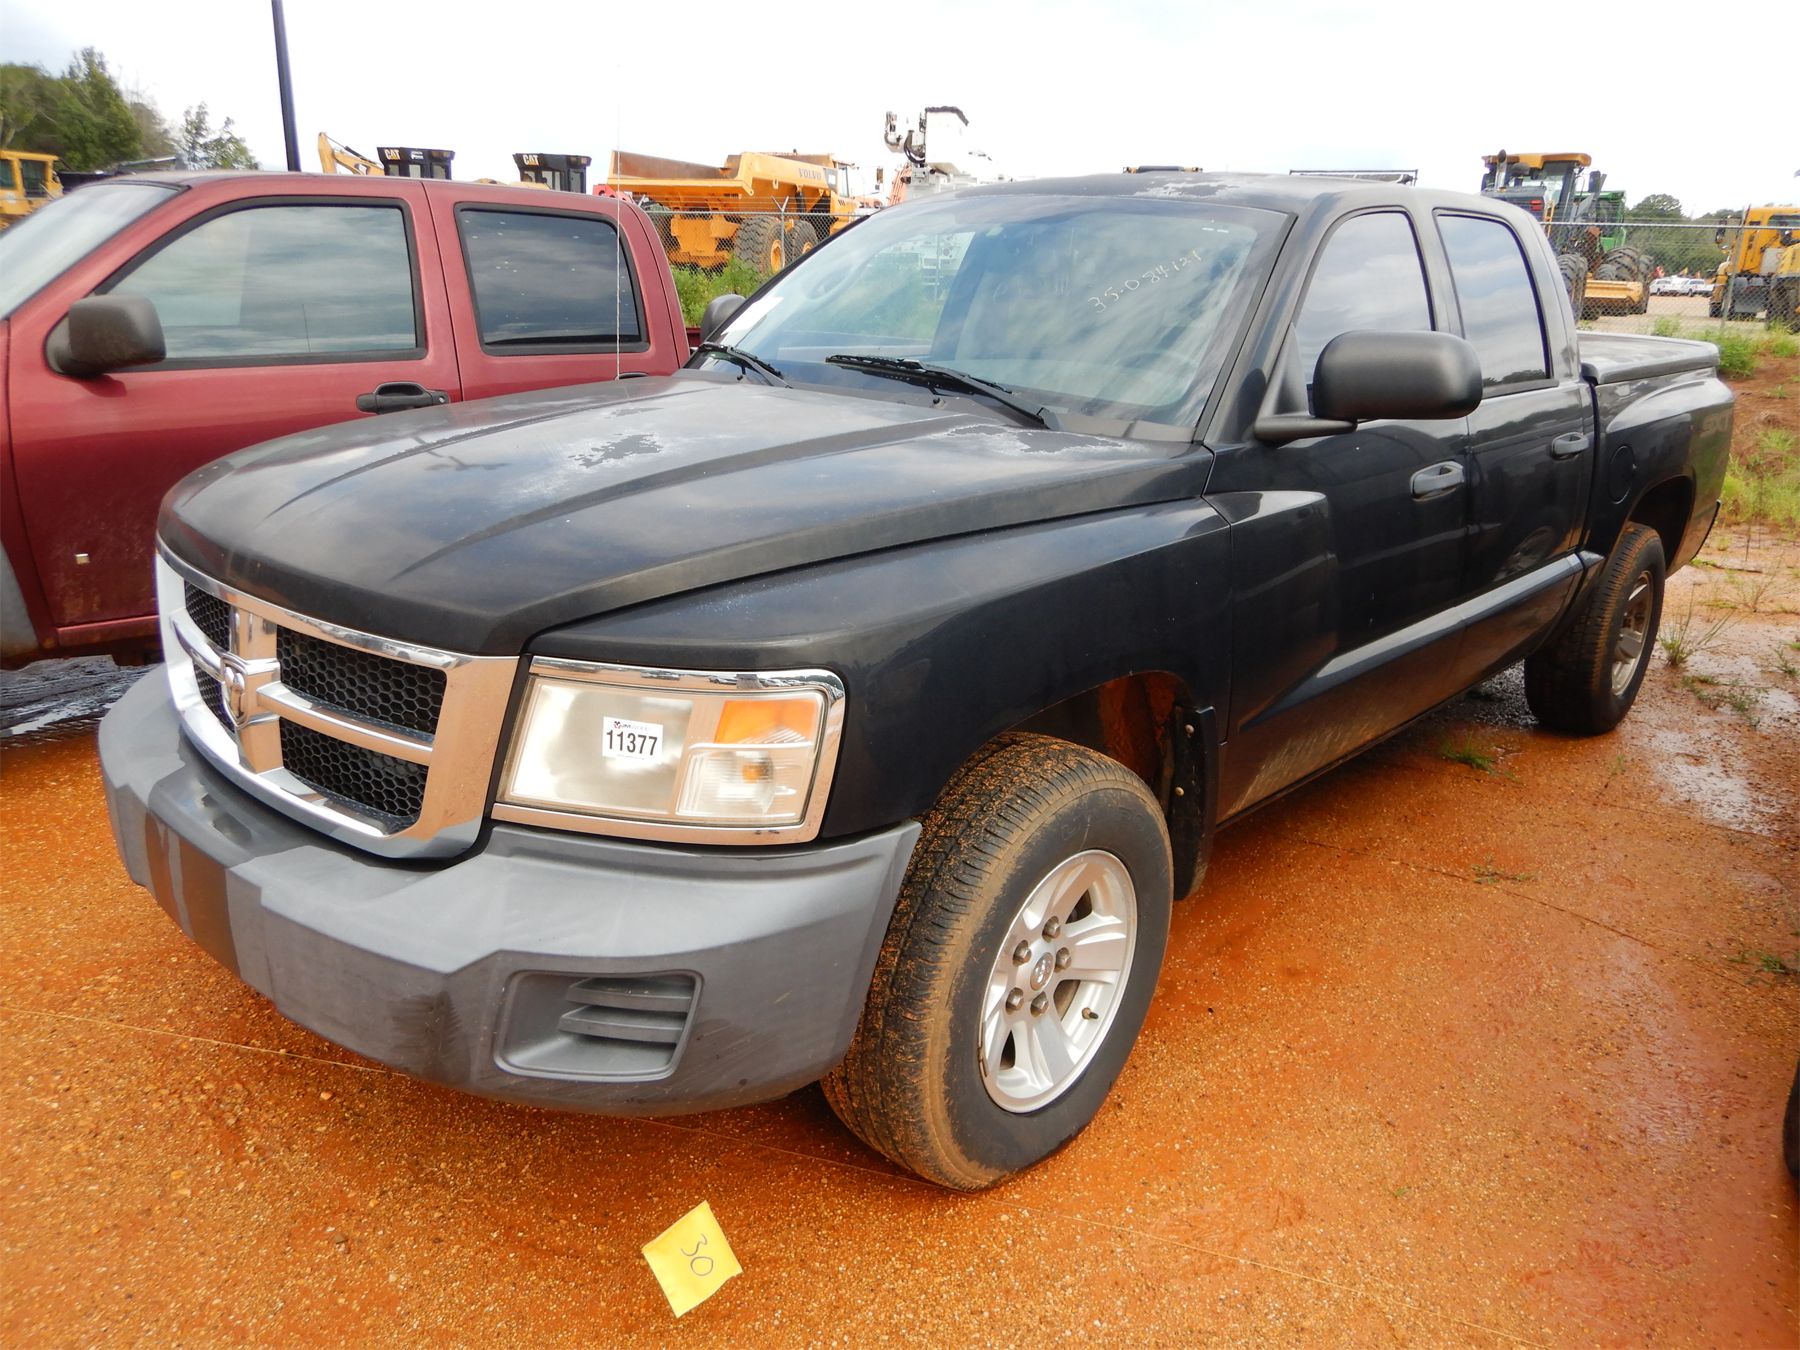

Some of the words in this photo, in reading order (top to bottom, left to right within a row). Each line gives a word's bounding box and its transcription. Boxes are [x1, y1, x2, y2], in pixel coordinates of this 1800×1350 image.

[384, 149, 400, 160] CAT
[522, 154, 540, 166] CAT
[798, 168, 822, 181] VOLVO
[606, 729, 658, 756] 11377
[680, 1233, 714, 1277] 30
